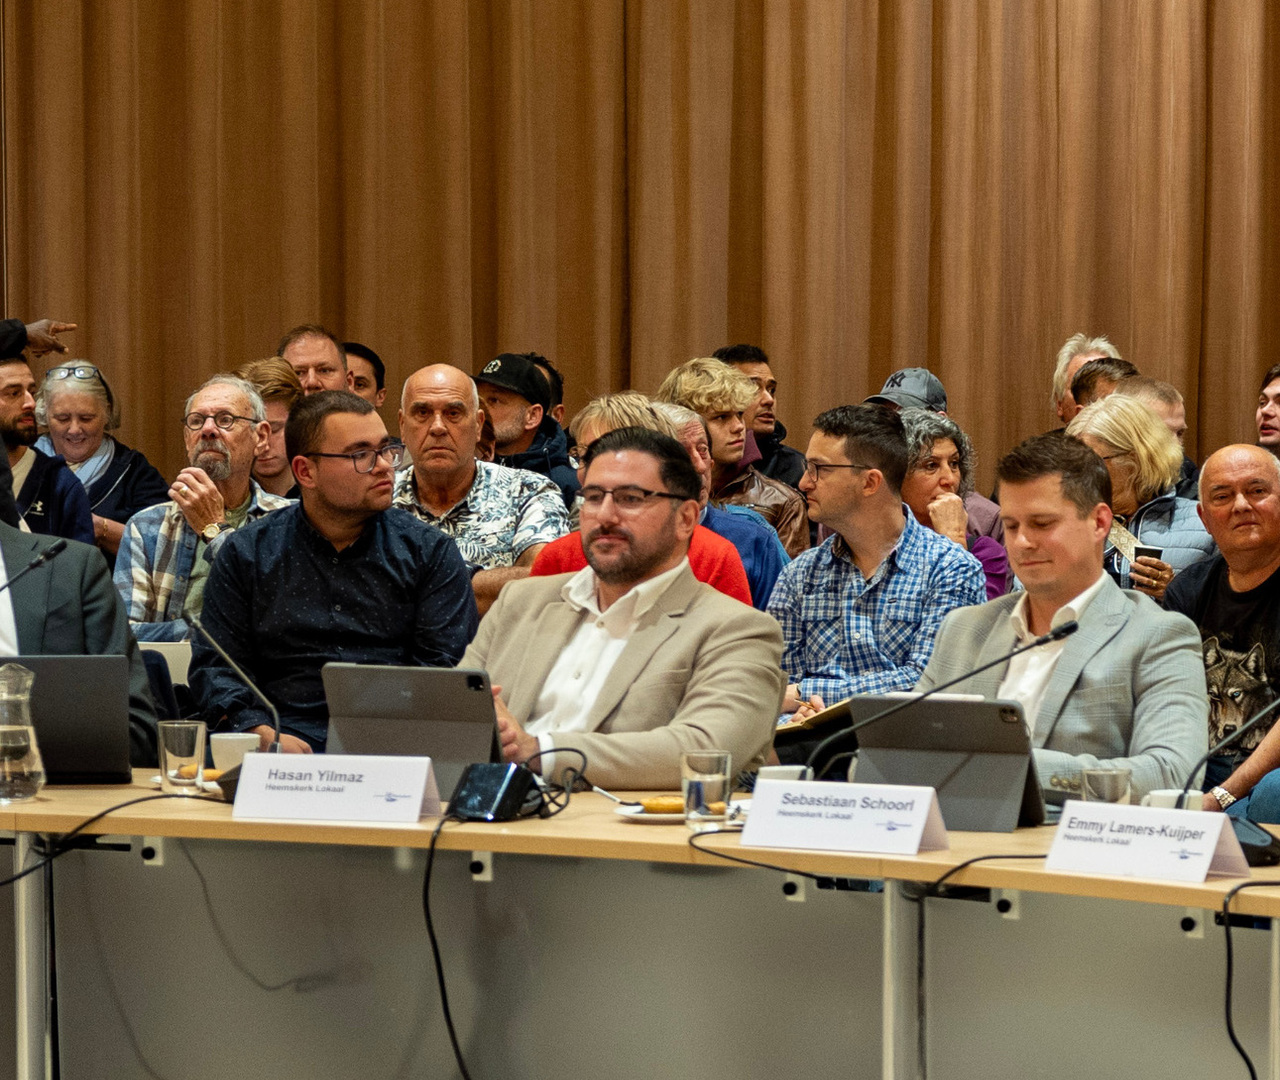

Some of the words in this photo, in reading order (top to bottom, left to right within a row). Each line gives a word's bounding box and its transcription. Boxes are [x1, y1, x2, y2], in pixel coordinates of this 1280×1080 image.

[267, 769, 312, 781] Hasan
[317, 770, 364, 783] Yilmaz
[265, 783, 313, 792] Heemskerk
[315, 785, 344, 793] Lokaal
[781, 792, 857, 808] Sebastiaan
[860, 796, 915, 811] Schoorl
[1067, 816, 1107, 833] Emmy
[1109, 820, 1206, 842] Lamers-Kuijper
